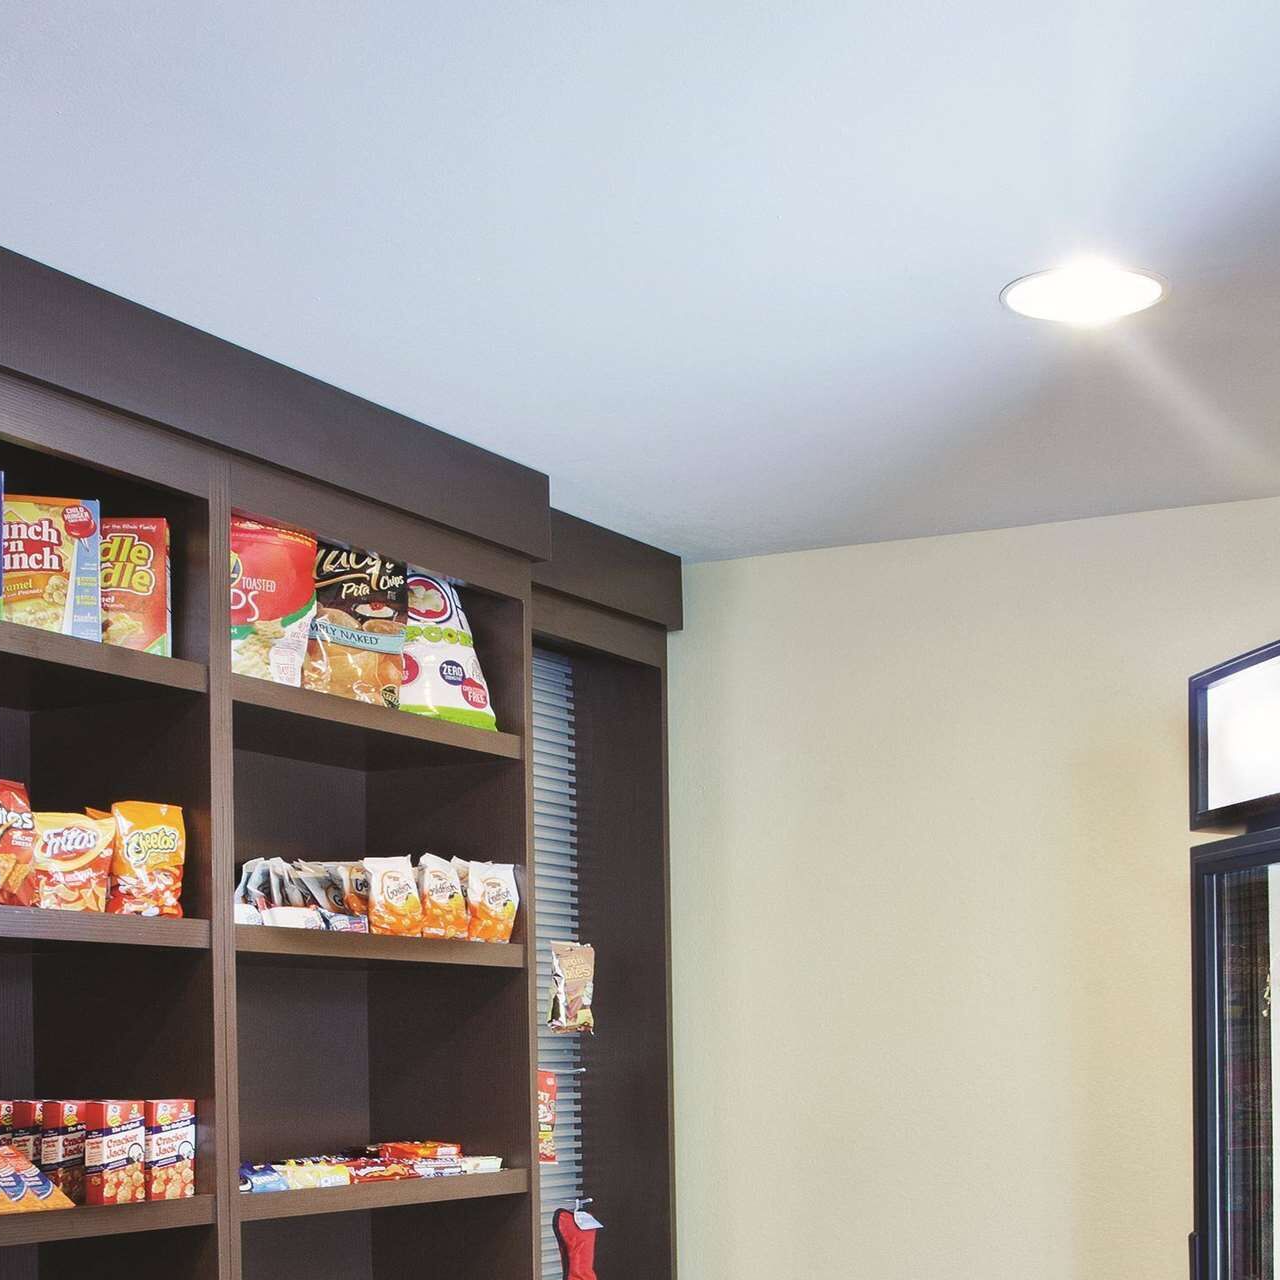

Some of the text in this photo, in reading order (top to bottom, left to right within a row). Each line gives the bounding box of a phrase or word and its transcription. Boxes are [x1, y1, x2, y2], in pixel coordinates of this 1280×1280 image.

[242, 576, 276, 592] TOASTED
[341, 583, 371, 599] Pita
[309, 623, 380, 645] MPLY NAKED
[126, 829, 178, 861] Cheetos
[428, 881, 458, 897] oldfish
